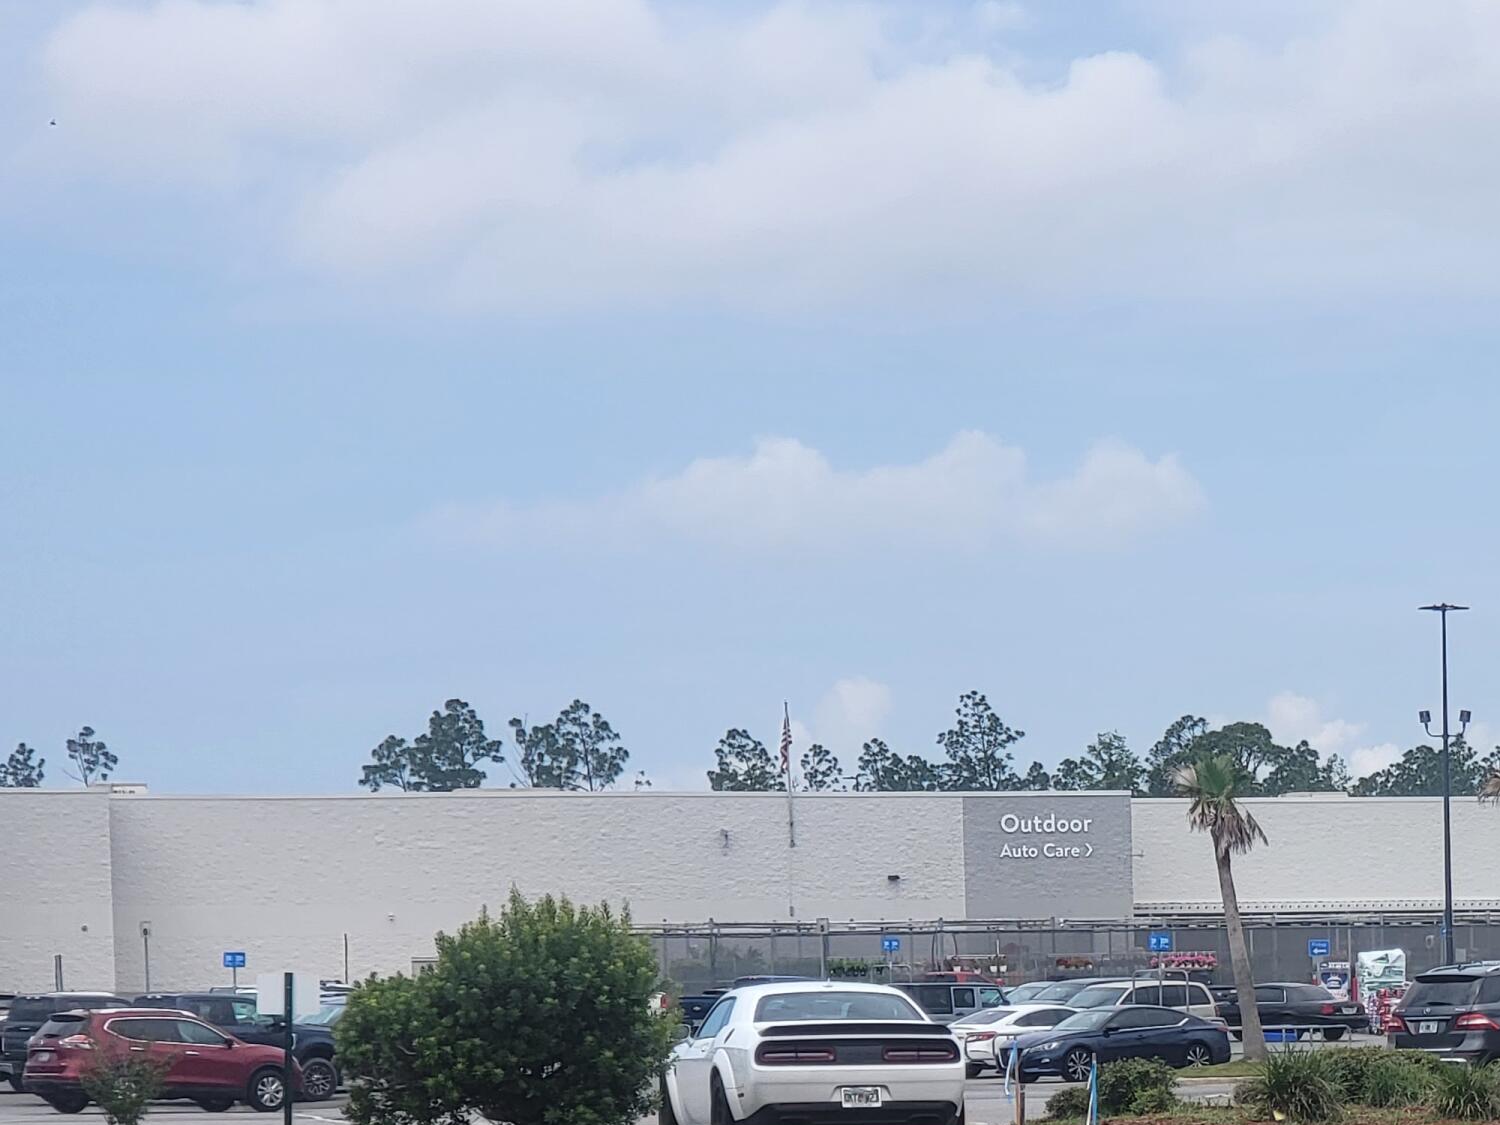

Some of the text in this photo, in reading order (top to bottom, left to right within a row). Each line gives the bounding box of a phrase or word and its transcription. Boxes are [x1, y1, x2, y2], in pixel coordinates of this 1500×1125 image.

[1000, 813, 1092, 833] Outdoor
[999, 843, 1080, 858] Auto Care
